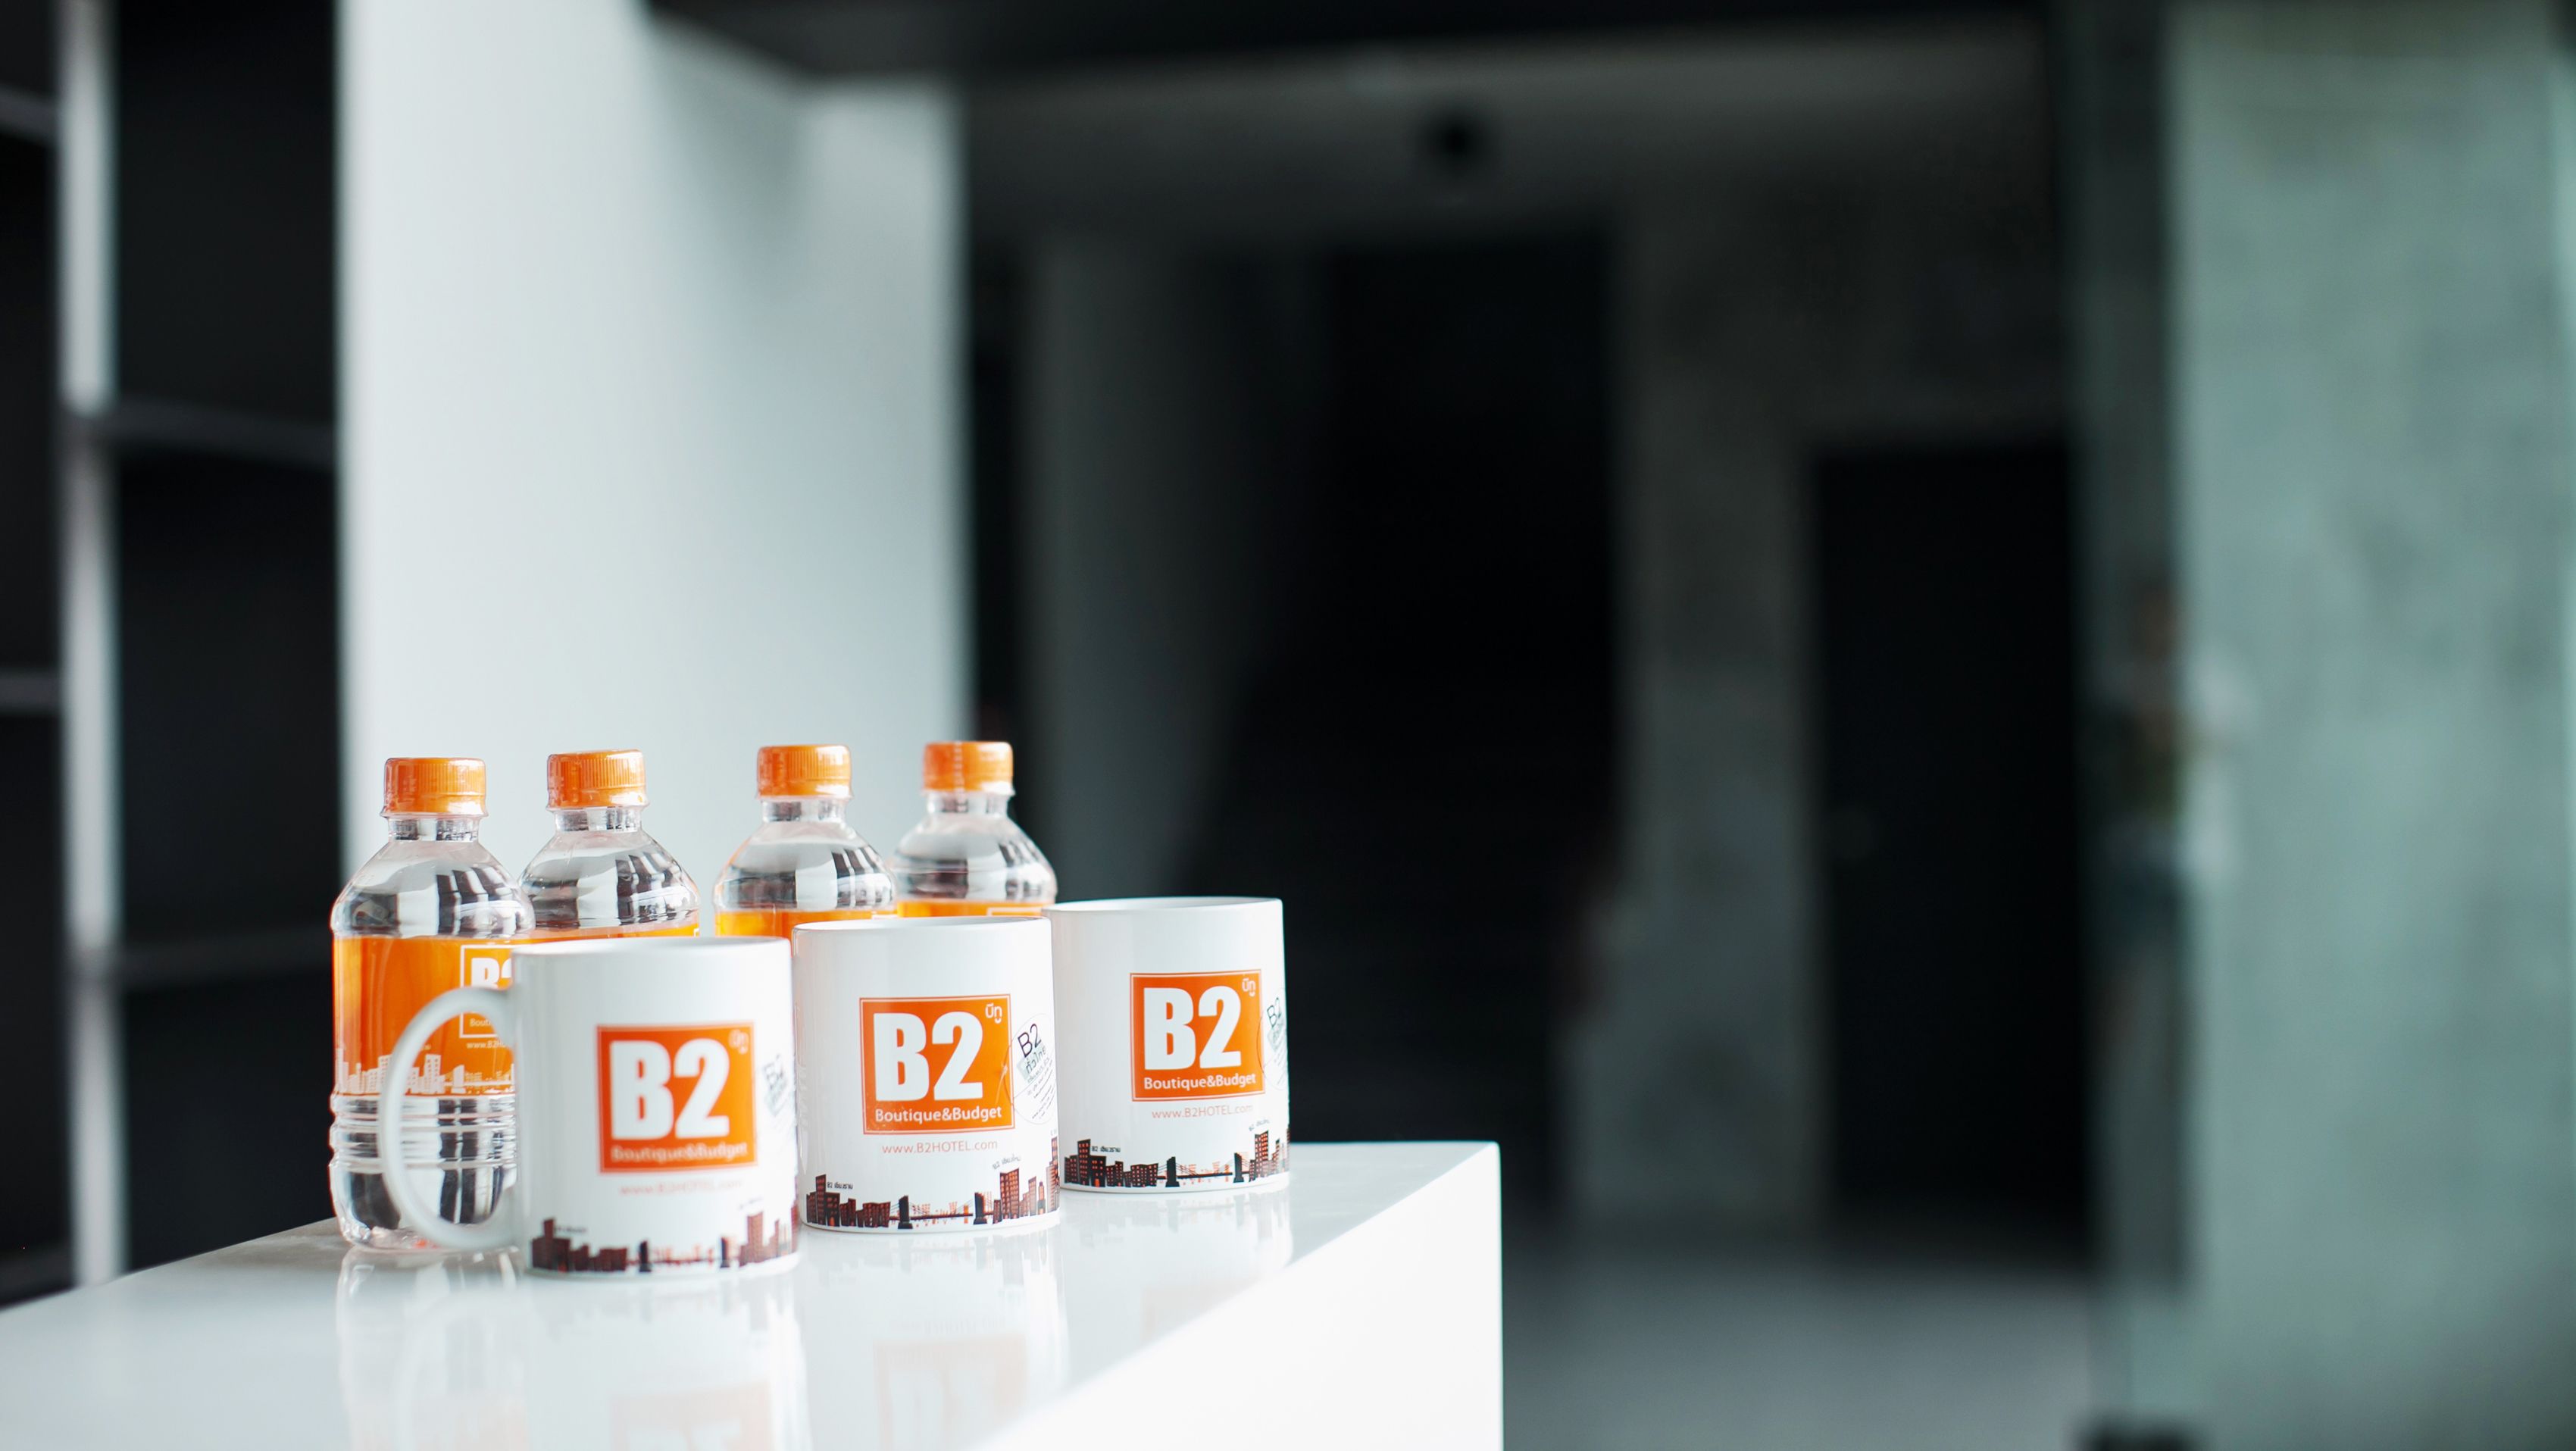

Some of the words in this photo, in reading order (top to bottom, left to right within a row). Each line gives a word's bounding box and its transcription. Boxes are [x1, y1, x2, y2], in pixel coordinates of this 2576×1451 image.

[1017, 1023, 1042, 1059] B2
[1143, 985, 1242, 1071] B2
[873, 1011, 983, 1102] B2
[609, 1037, 730, 1140] B2
[1143, 1072, 1257, 1091] Boutique&Budget
[875, 1105, 1002, 1124] Boutique&Budget
[882, 1140, 999, 1155] www.B2HOTEL.com
